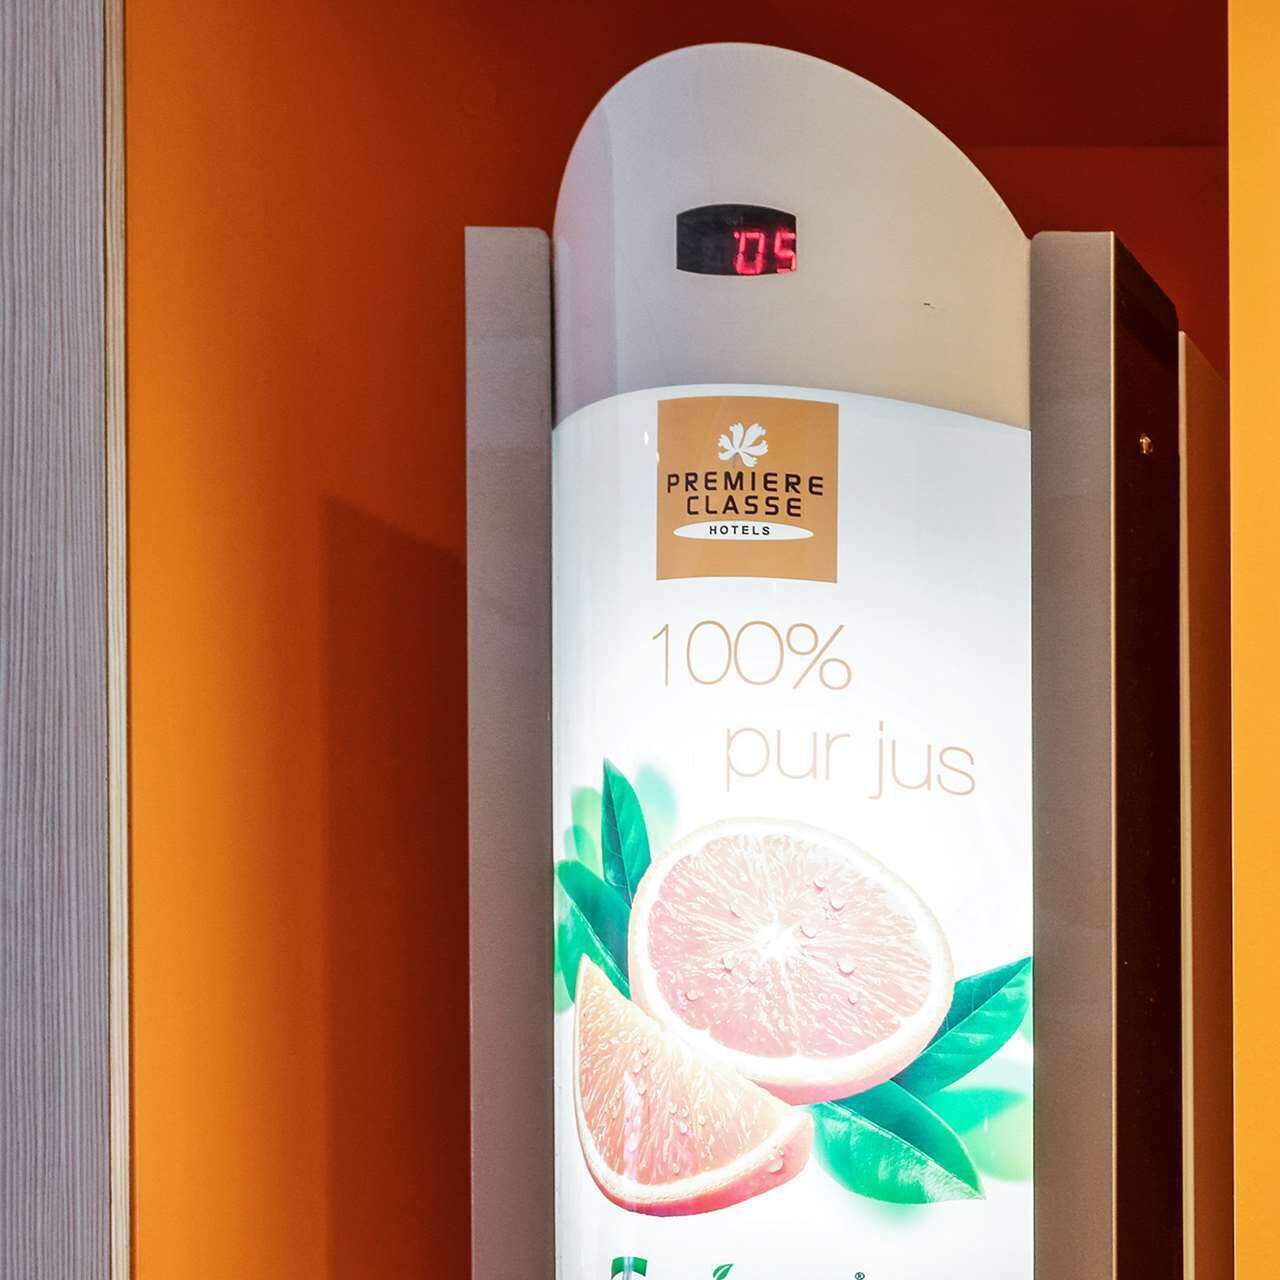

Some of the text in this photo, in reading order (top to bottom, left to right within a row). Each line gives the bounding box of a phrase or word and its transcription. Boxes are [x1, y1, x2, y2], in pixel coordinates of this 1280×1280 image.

[667, 471, 825, 496] PREMIERE
[686, 495, 803, 518] CLASSE
[709, 525, 771, 536] HOTELS
[652, 620, 852, 691] 100%
[726, 720, 977, 800] pur jus
